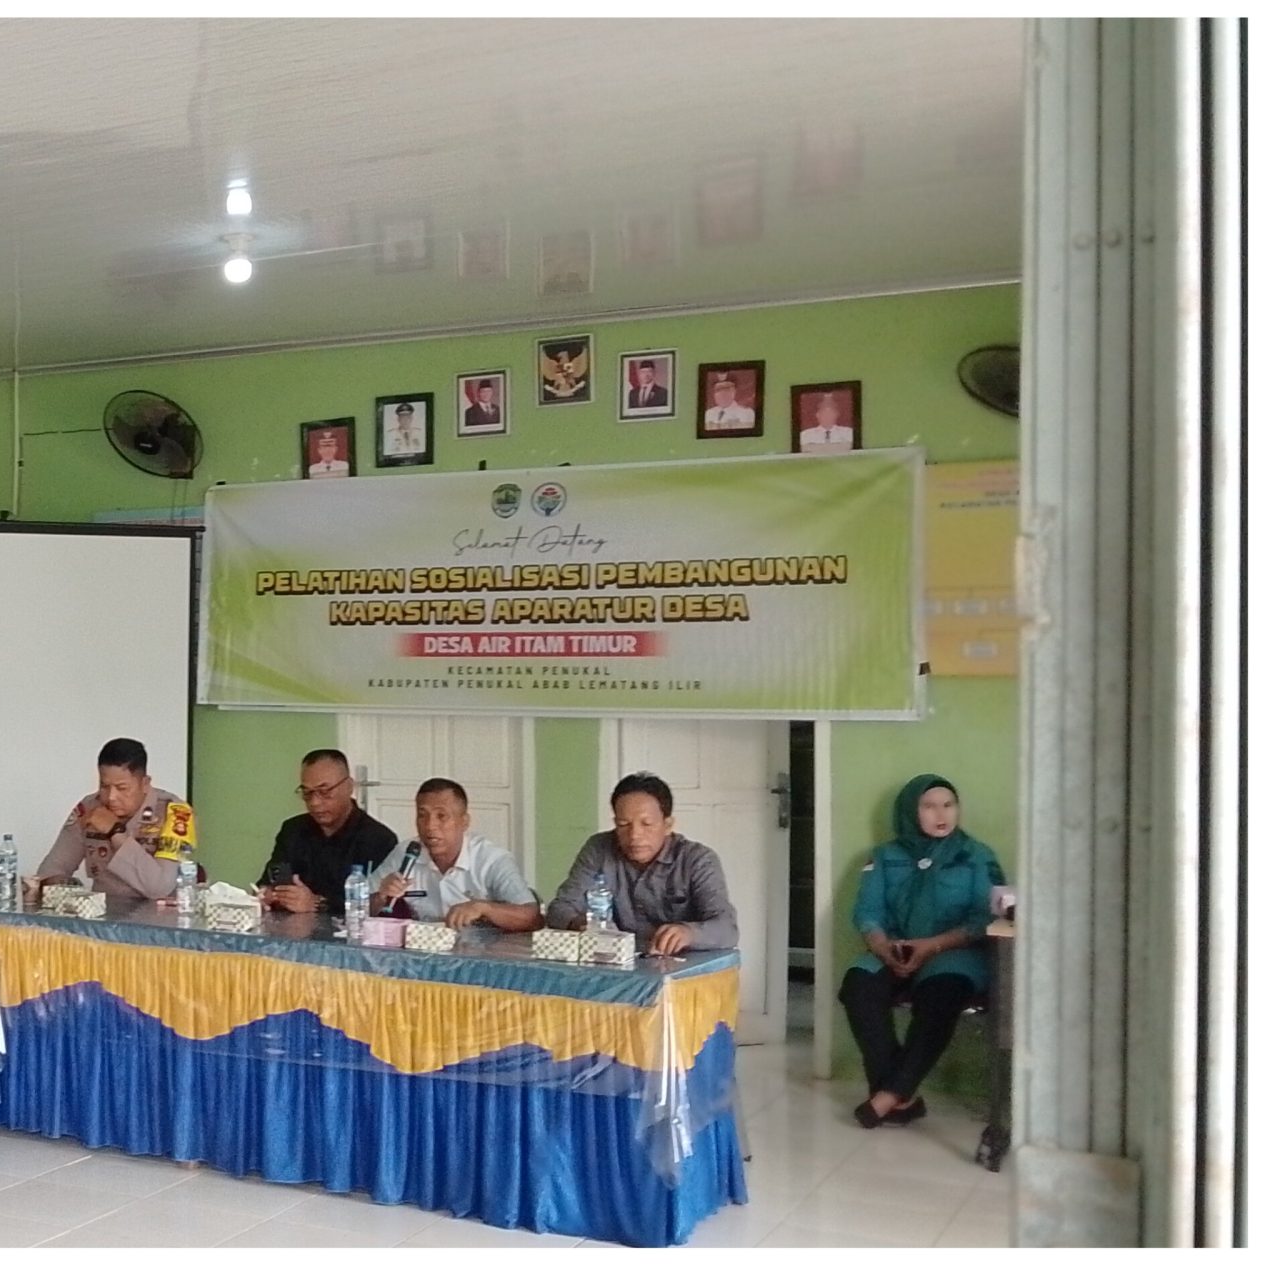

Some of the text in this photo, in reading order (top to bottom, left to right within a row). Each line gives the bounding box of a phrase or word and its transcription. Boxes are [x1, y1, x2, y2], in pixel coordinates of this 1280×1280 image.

[452, 522, 608, 558] Selamat Datang
[256, 556, 847, 596] PELATIHAN SOSIALISASI PEMBANGUNAN
[328, 593, 750, 626] KAPASITAS APARATUR DESA
[423, 634, 637, 654] DESA AIR ITAM TIMUR
[447, 665, 611, 676] KECAMATAN PENUKAL
[368, 678, 703, 691] KABUPATEN PENUKAL ABAB LEMATANG ILIR
